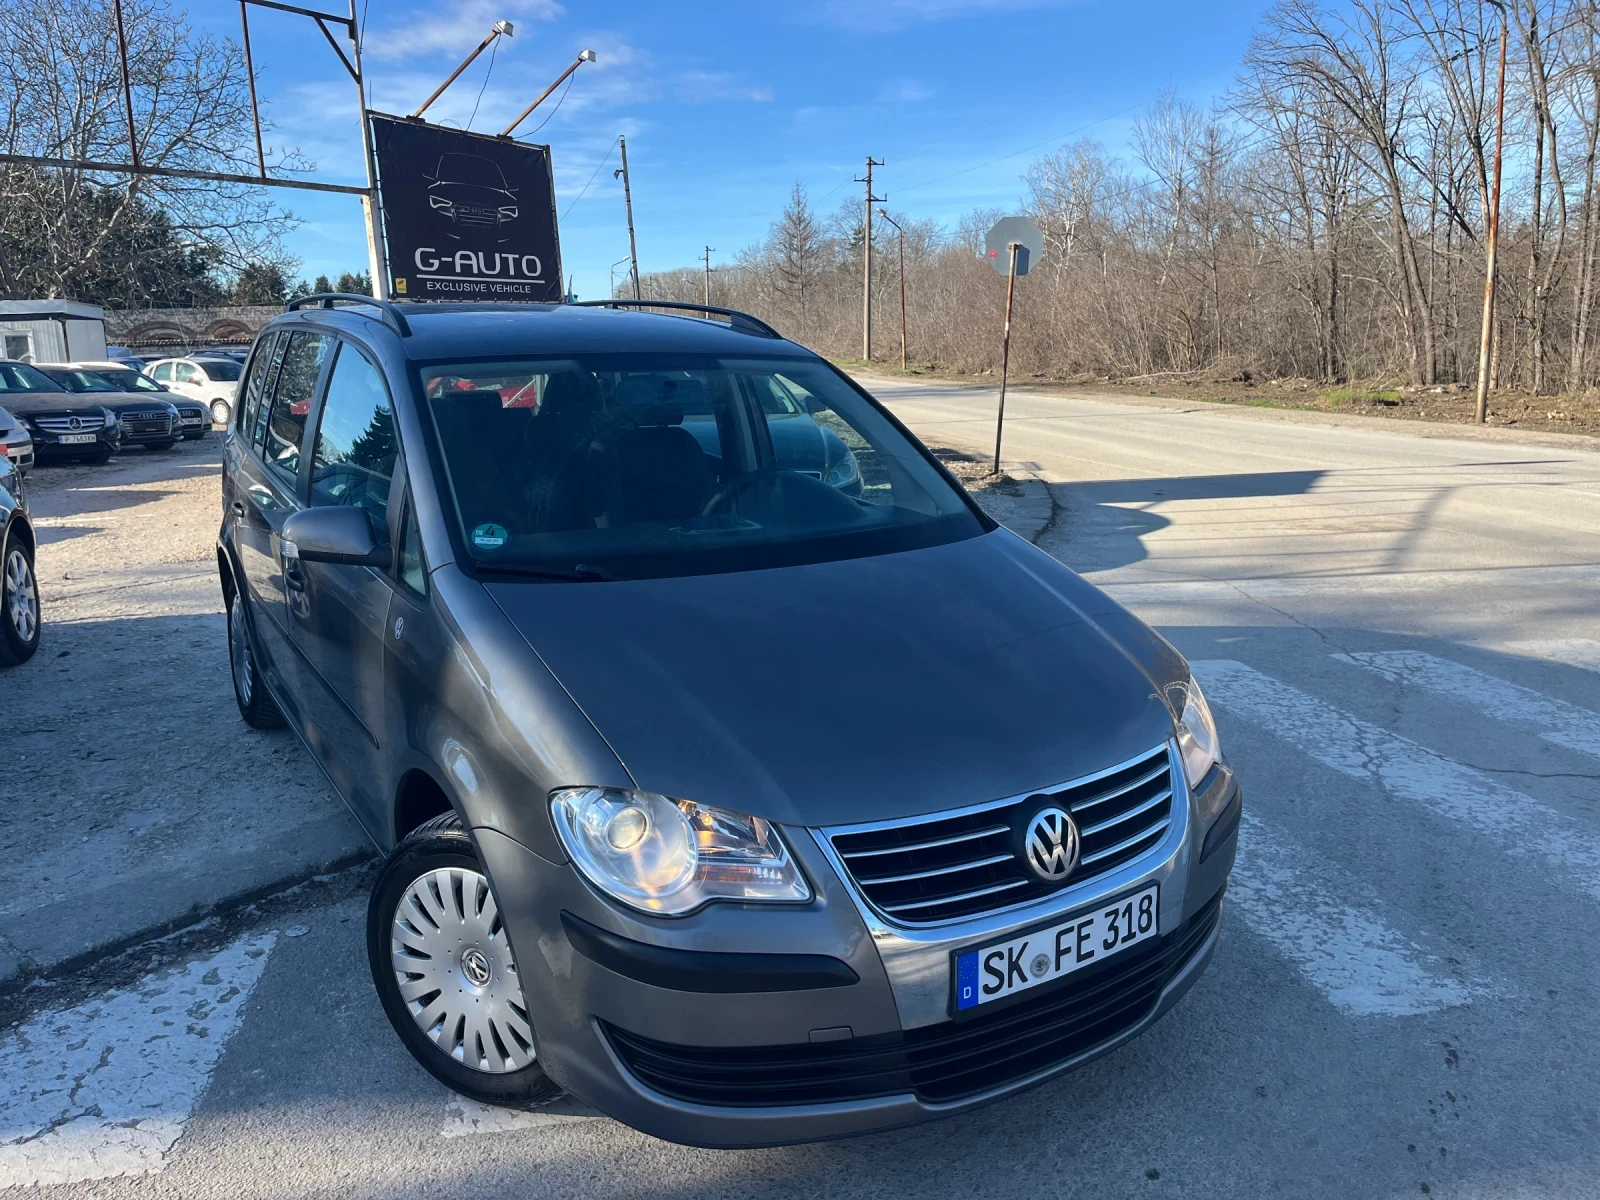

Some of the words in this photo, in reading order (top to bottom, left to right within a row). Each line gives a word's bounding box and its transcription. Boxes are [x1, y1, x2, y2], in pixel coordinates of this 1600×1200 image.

[414, 247, 542, 277] G-AUTO
[426, 281, 487, 293] EXCLUSIVE
[489, 282, 532, 294] VEHICLE
[484, 525, 495, 537] 4
[1028, 809, 1078, 879] VW
[963, 986, 972, 1000] D
[982, 941, 1030, 996] SK
[1054, 918, 1095, 972] FE
[1102, 893, 1153, 951] 318
